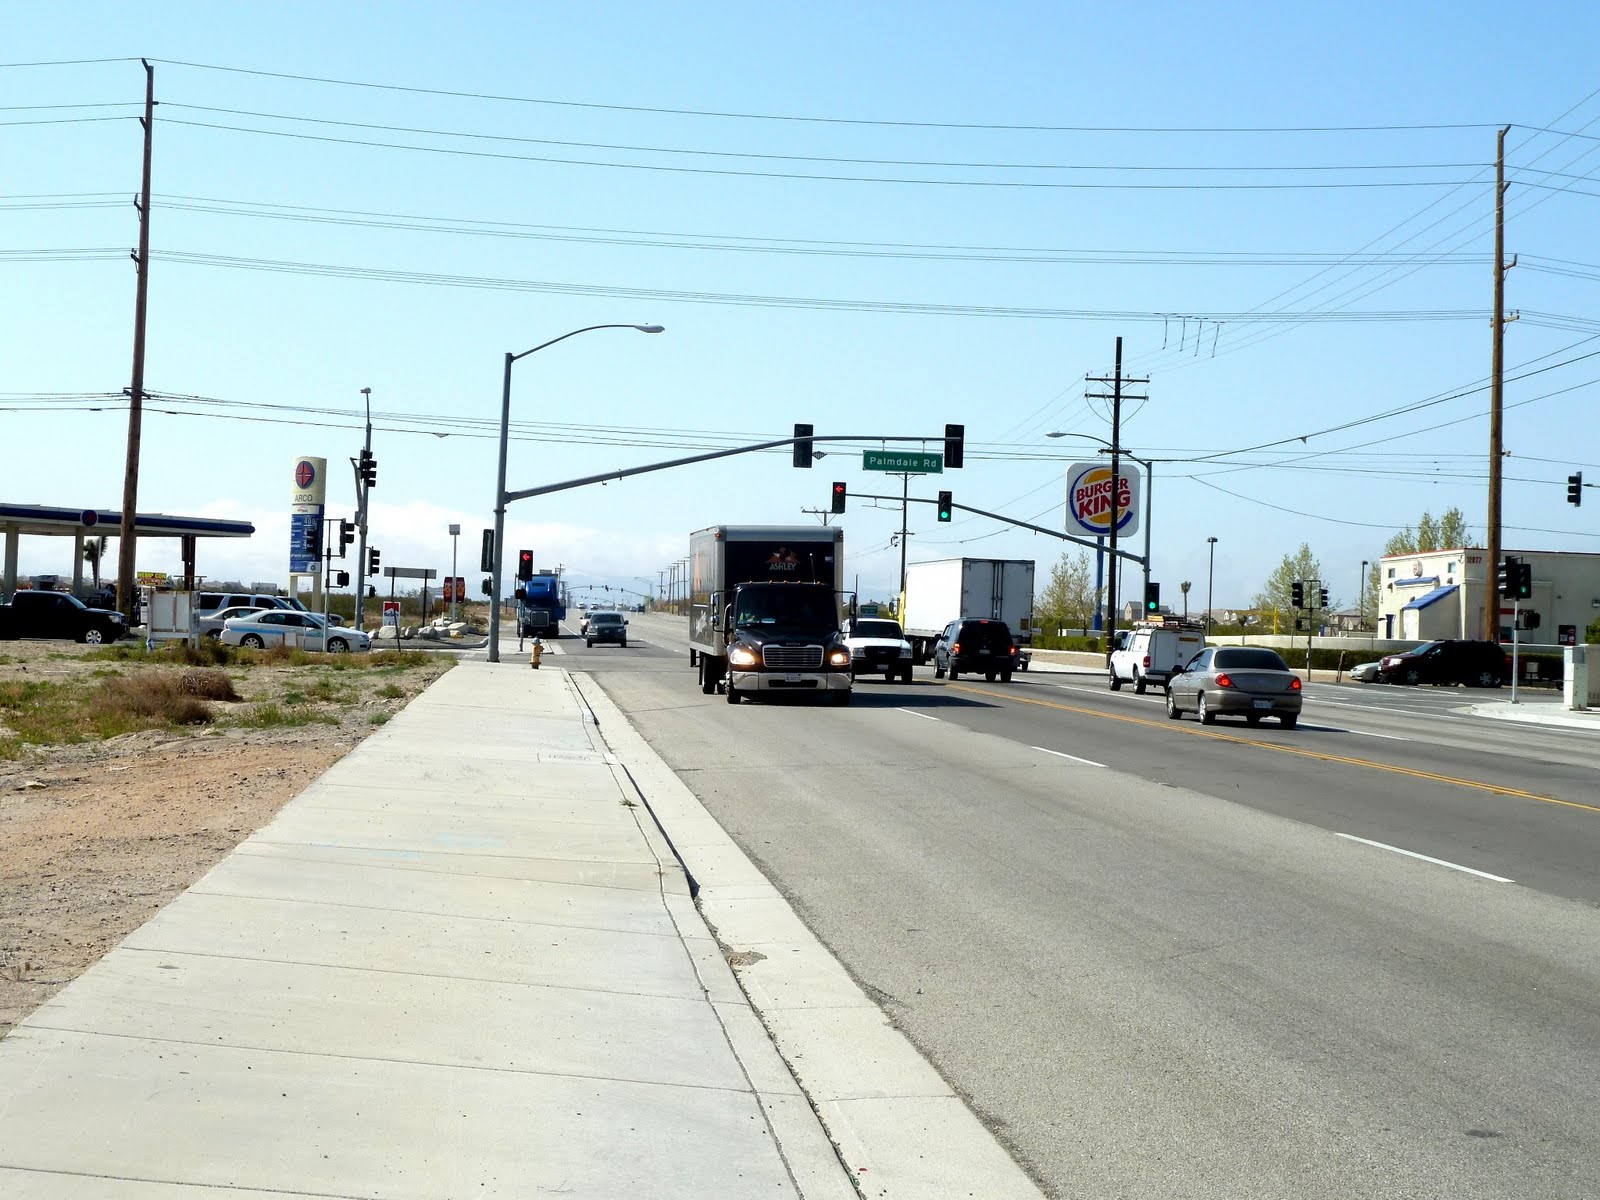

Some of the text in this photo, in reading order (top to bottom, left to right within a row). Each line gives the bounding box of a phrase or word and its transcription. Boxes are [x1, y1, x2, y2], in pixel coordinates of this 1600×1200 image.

[869, 456, 937, 468] Palmdale Rd
[1076, 478, 1129, 502] BURGR
[294, 494, 313, 502] ARCO
[769, 562, 797, 571] ASHLEY
